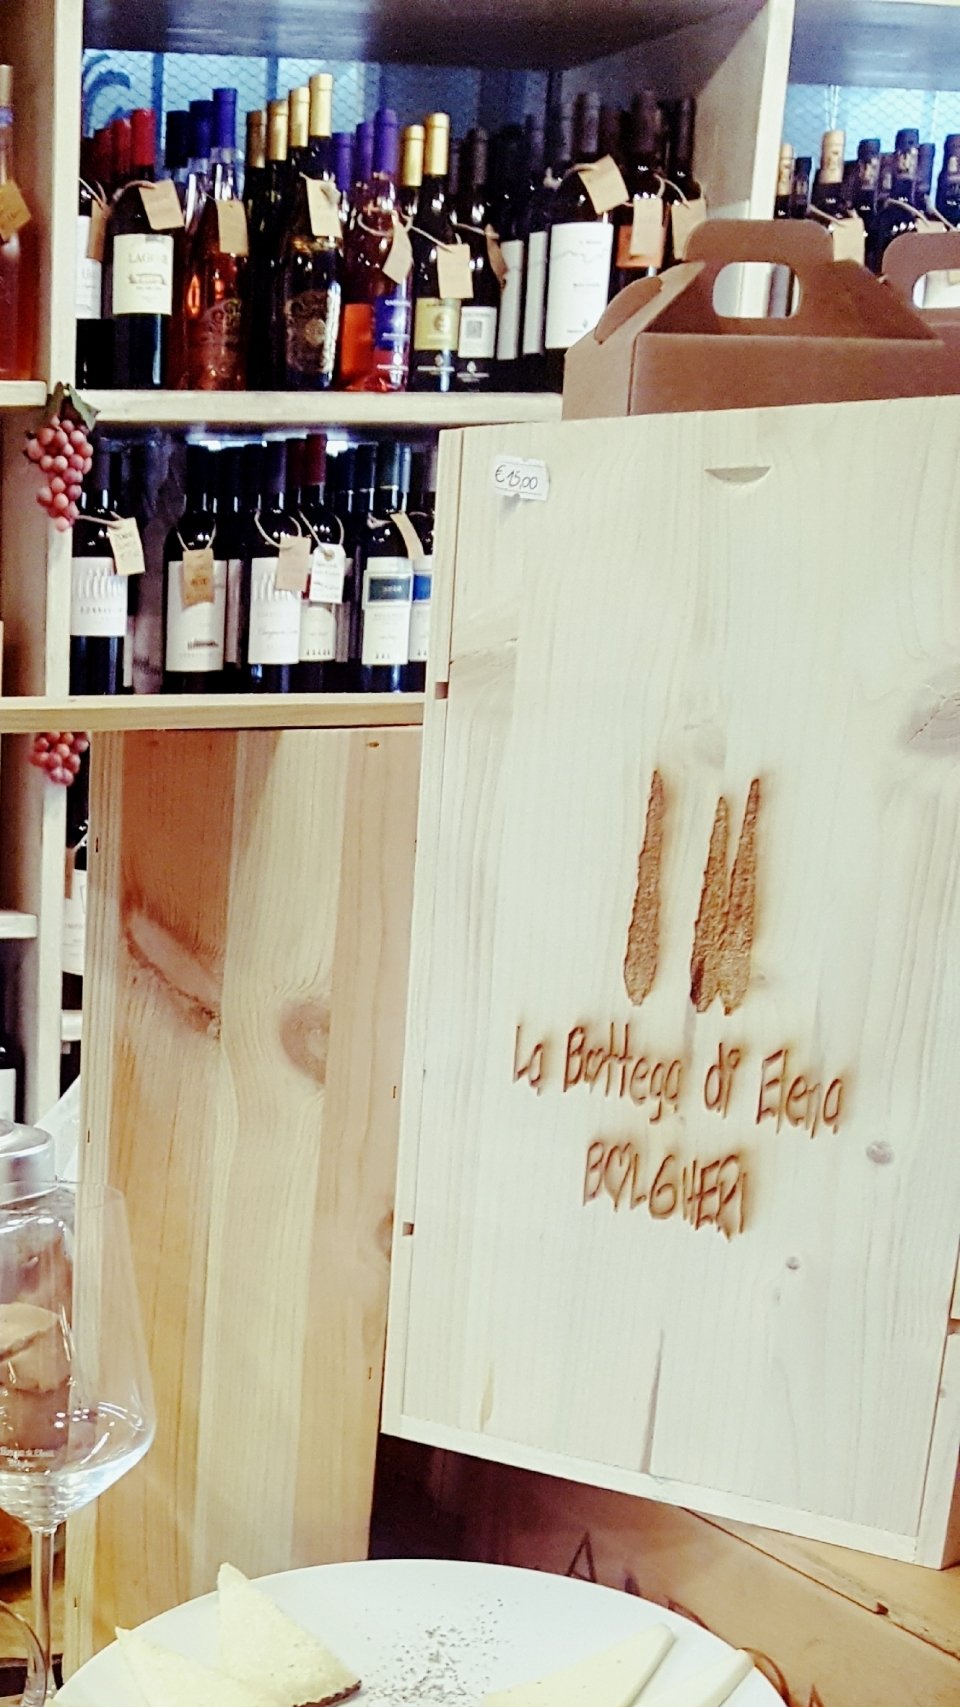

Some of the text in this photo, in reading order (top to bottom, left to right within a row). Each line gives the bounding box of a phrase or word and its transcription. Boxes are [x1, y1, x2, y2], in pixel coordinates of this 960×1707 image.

[513, 1021, 843, 1139] La Bottega di Elena
[583, 1141, 748, 1242] BOLGHERI
